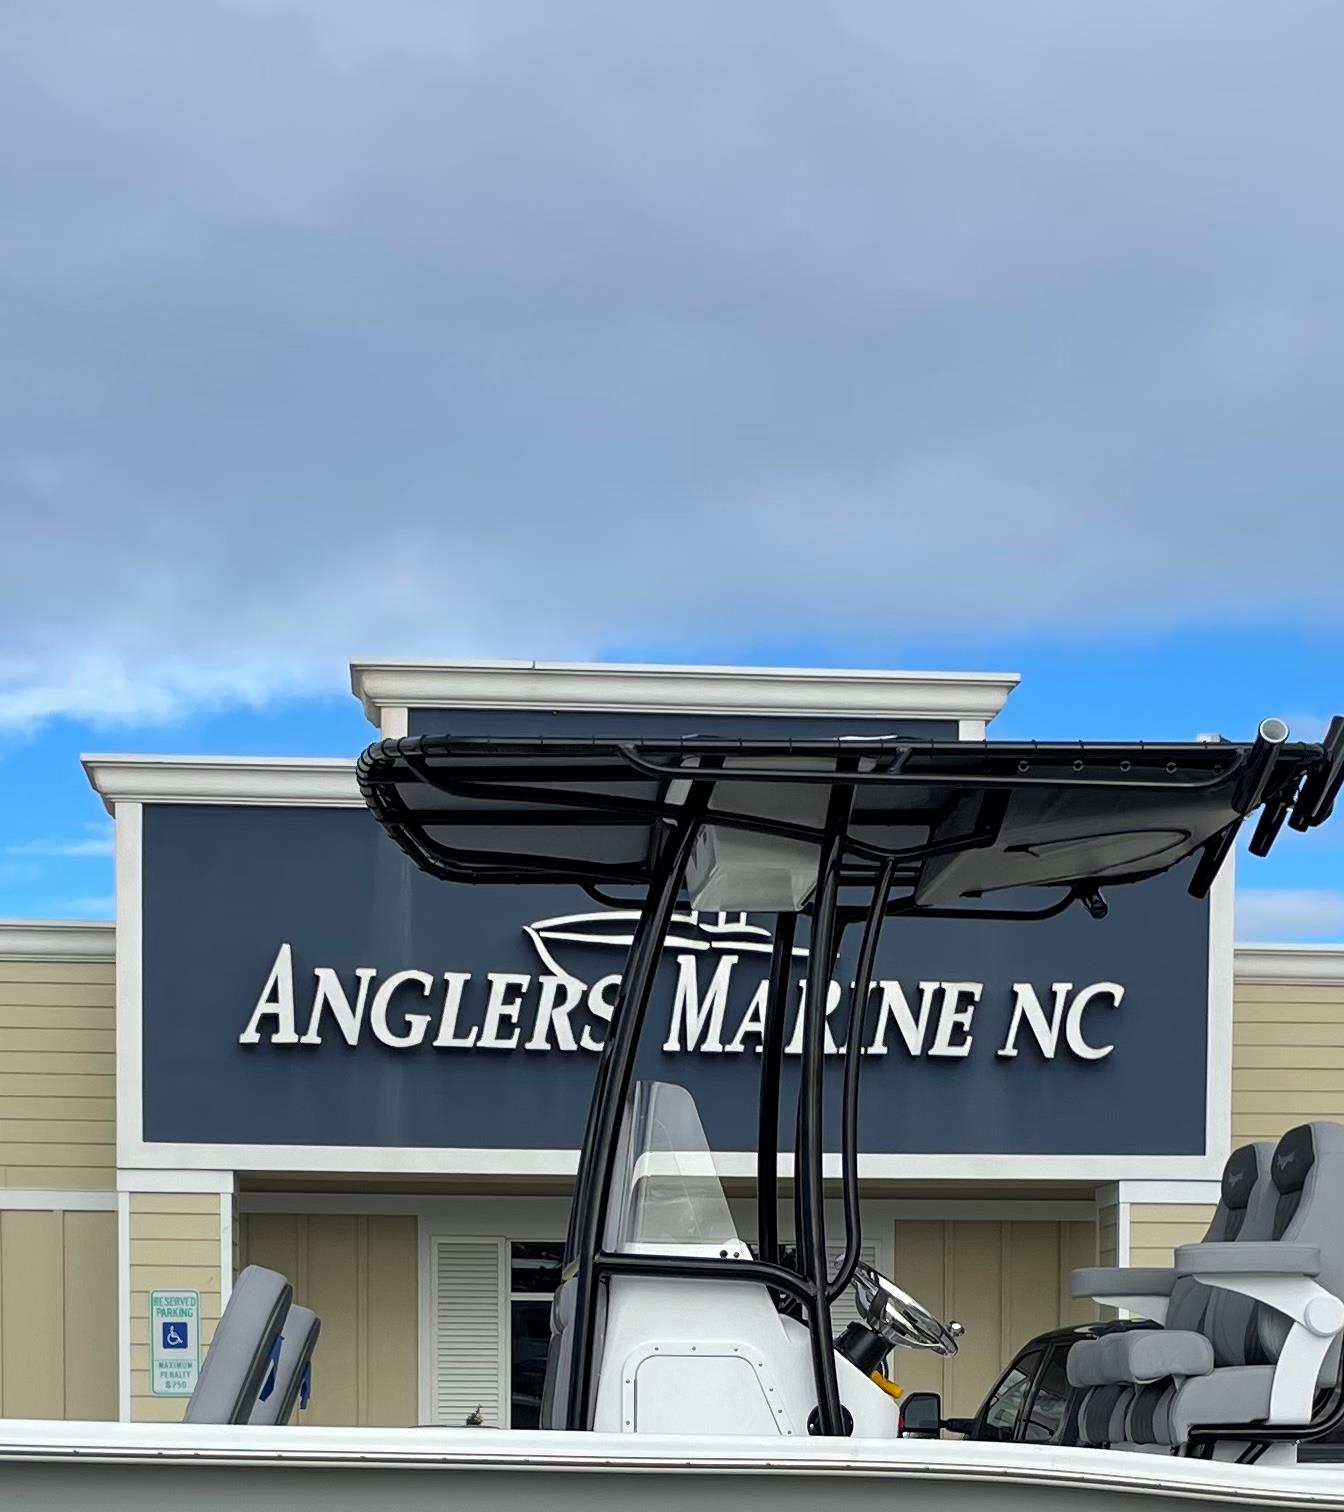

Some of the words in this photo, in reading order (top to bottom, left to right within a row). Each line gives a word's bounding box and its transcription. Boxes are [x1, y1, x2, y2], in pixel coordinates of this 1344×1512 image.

[239, 943, 621, 1053] ANGLERS
[997, 982, 1125, 1059] NC
[152, 1296, 196, 1306] RESERVED
[156, 1308, 193, 1317] PARKING
[158, 1361, 193, 1369] MAXIMUM
[160, 1371, 191, 1379] PENALTY
